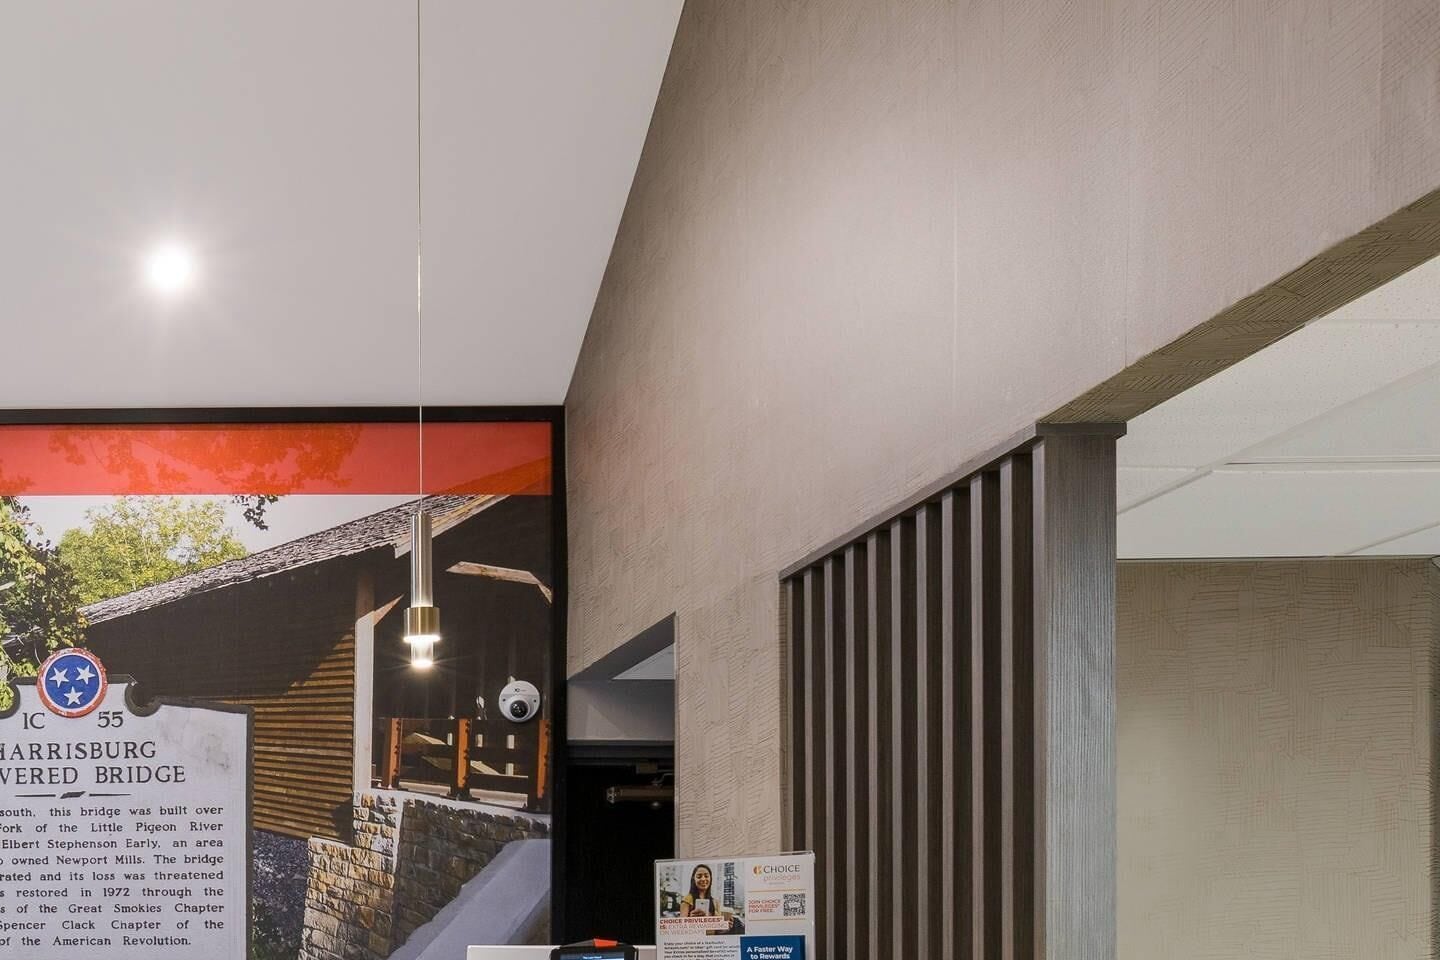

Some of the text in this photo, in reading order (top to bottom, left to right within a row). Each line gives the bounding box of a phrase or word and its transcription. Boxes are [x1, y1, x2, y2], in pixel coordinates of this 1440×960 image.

[97, 710, 124, 728] 55
[95, 765, 185, 784] BRIDGE
[50, 806, 71, 816] this
[80, 806, 120, 818] bridge
[129, 807, 151, 815] was
[160, 805, 187, 815] built
[196, 806, 223, 814] over
[36, 823, 47, 832] of
[59, 823, 77, 832] the
[91, 822, 123, 832] Little
[136, 821, 176, 834] Pigeon
[190, 820, 223, 831] River
[2, 839, 39, 849] Elbert
[48, 839, 117, 850] Stephenson
[196, 839, 223, 847] area
[12, 855, 48, 865] owned
[56, 855, 107, 866] Newport
[116, 854, 144, 864] Mills.
[153, 854, 176, 864] The
[184, 853, 224, 866] bridge
[763, 864, 801, 873] CHOICE
[40, 871, 61, 880] and
[70, 871, 84, 880] its
[93, 871, 115, 880] loss
[154, 870, 223, 880] threatened
[16, 887, 67, 897] restored
[81, 887, 91, 896] in
[104, 887, 130, 897] 1972
[142, 886, 192, 899] through
[204, 886, 223, 896] the
[17, 903, 28, 913] of
[39, 903, 57, 913] the
[69, 903, 102, 913] Great
[114, 903, 161, 913] Smokies
[175, 902, 224, 914] Chapter
[62, 919, 95, 929] Clack
[111, 919, 161, 931] Chapter
[177, 919, 189, 929] of
[204, 919, 224, 929] the
[0, 936, 10, 945] of
[21, 936, 40, 945] the
[53, 935, 111, 945] American
[123, 935, 191, 945] Revolution.
[777, 945, 793, 954] Way
